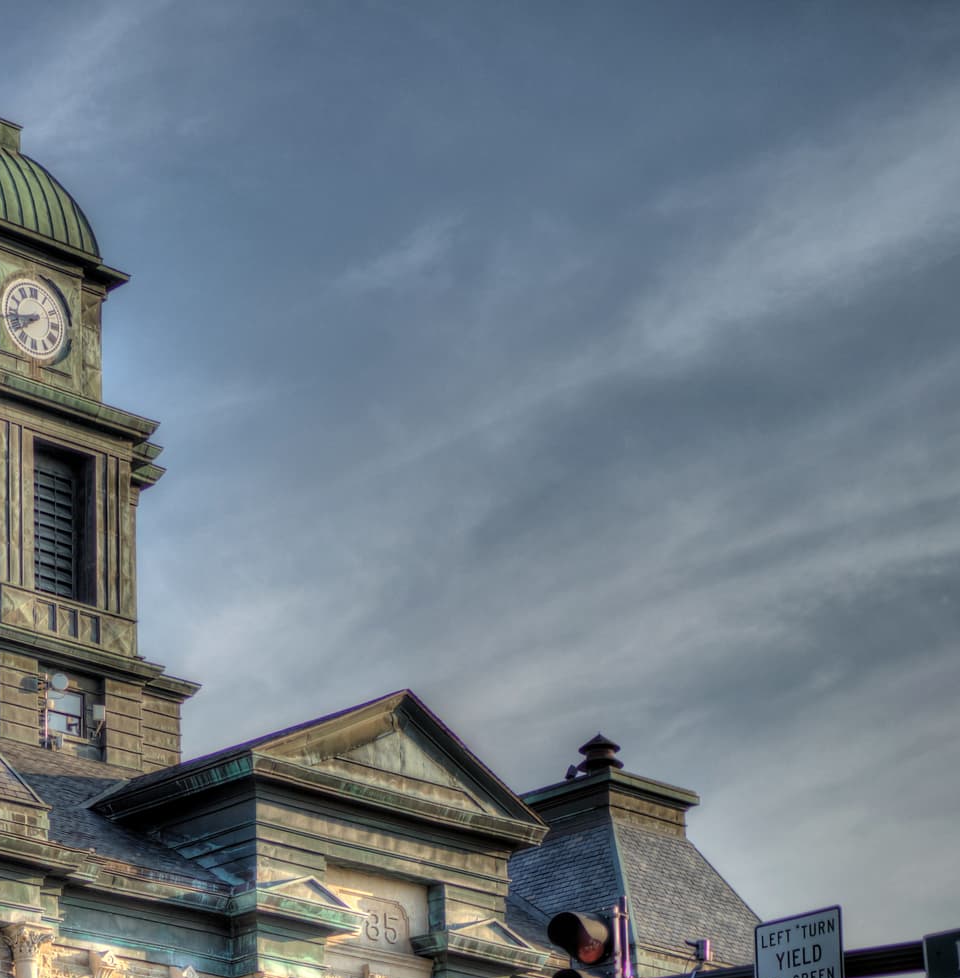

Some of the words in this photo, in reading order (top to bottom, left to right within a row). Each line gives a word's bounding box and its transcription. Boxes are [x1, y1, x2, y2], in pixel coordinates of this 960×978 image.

[761, 929, 791, 949] LEFT
[801, 918, 835, 939] TURN
[776, 944, 822, 970] YIELD
